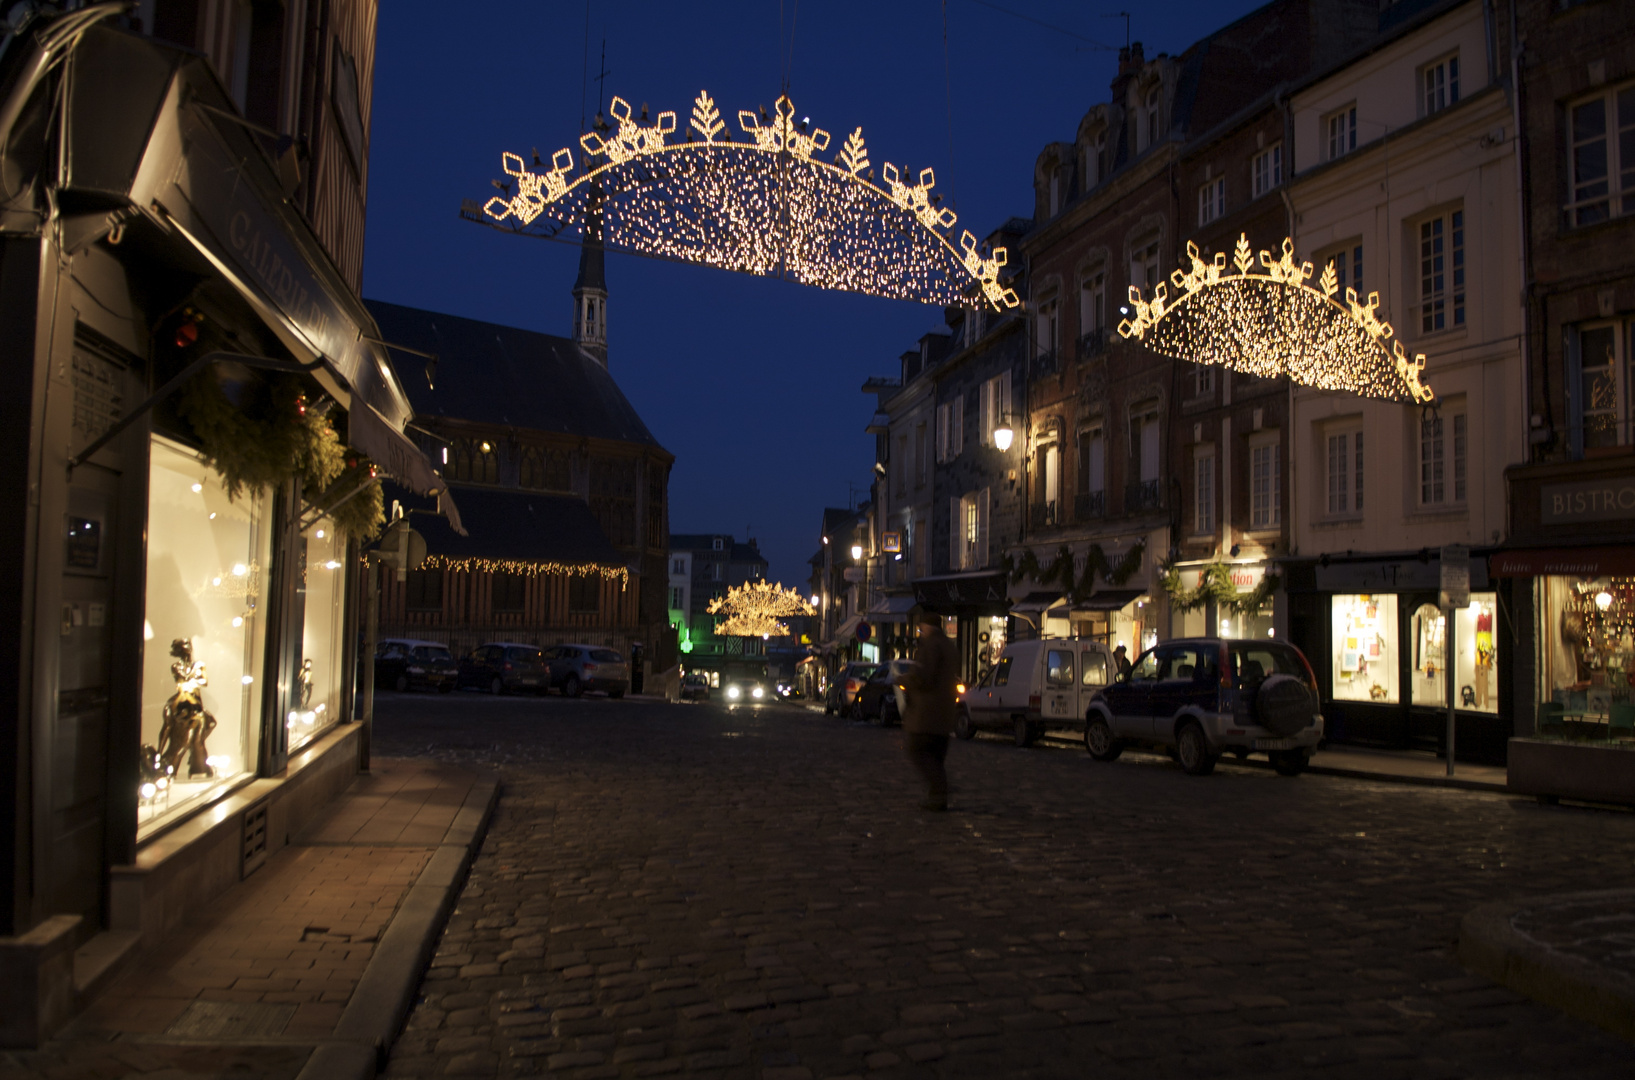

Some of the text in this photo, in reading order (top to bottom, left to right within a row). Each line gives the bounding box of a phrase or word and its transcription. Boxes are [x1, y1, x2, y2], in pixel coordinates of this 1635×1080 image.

[229, 208, 309, 321] GALERIE
[1552, 486, 1635, 516] BISTRO
[1502, 560, 1599, 573] bistro restaurant
